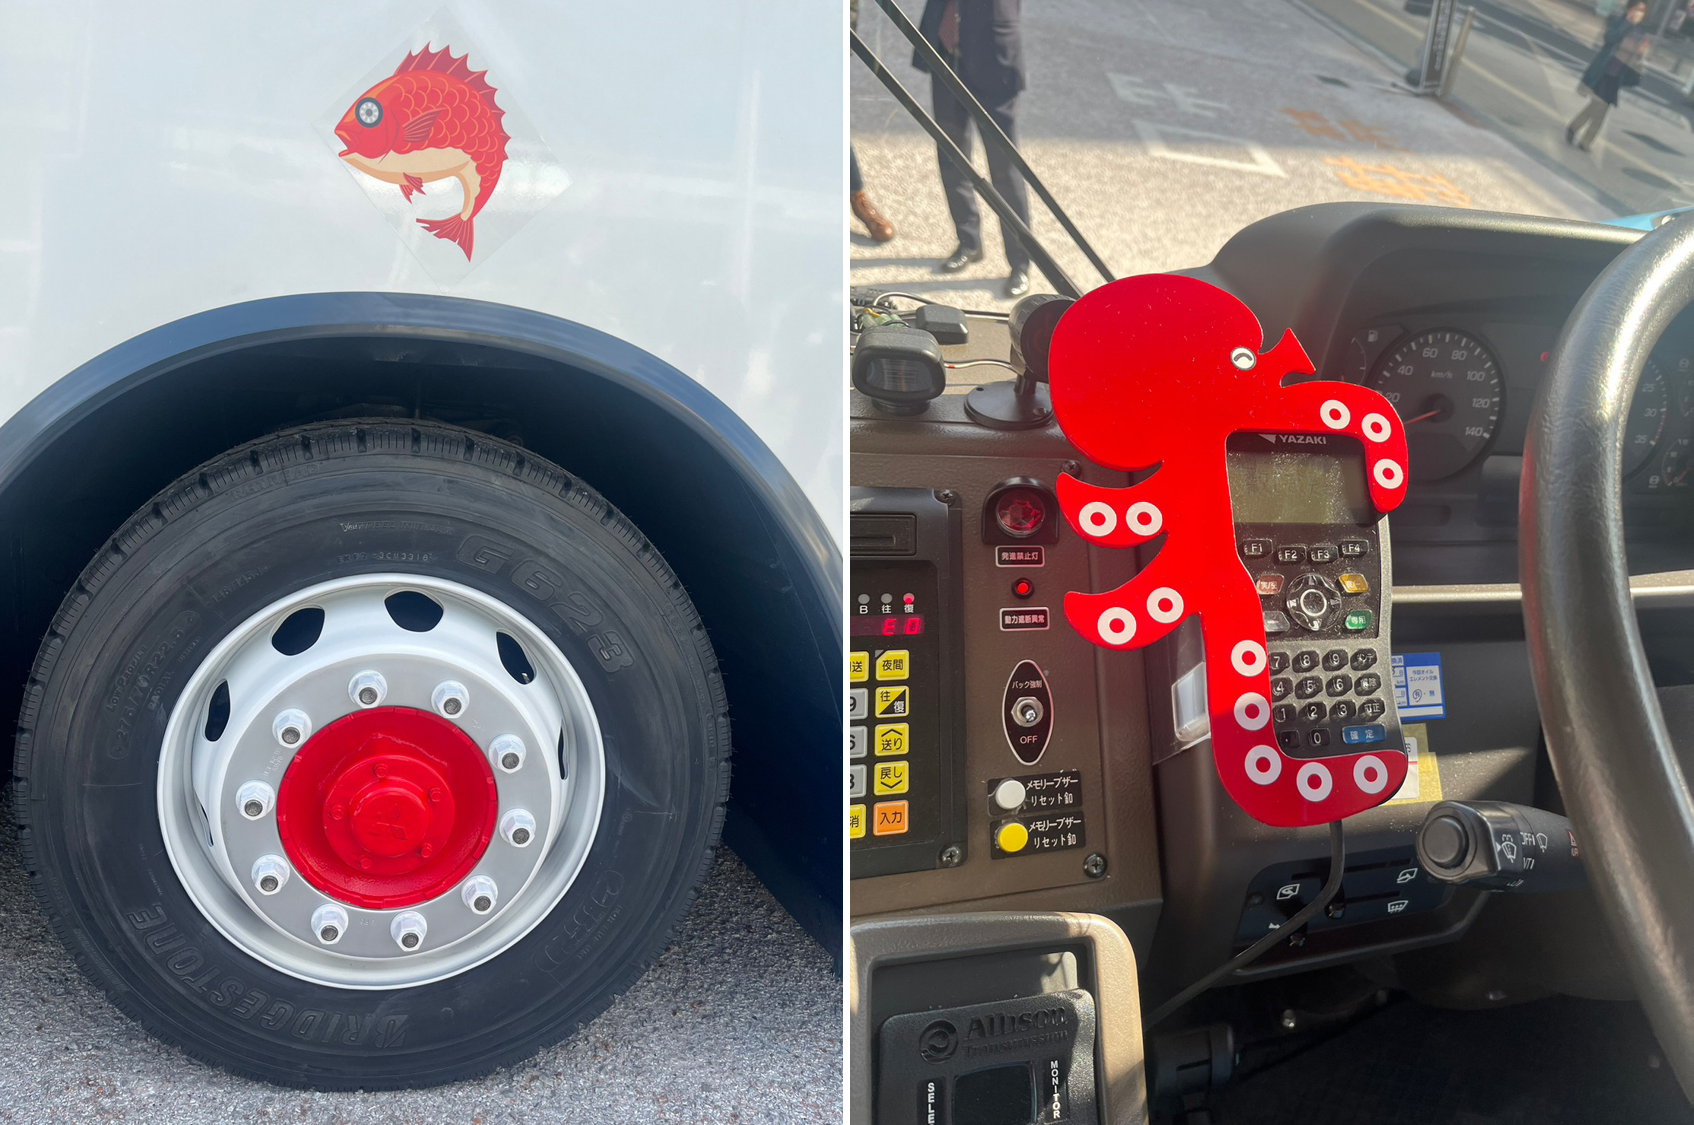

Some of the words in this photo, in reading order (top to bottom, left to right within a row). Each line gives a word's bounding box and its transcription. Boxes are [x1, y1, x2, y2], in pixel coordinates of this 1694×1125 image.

[1422, 347, 1438, 358] 60
[1451, 350, 1467, 361] 80
[1397, 365, 1413, 376] 40
[1431, 370, 1453, 380] km/h
[1466, 370, 1485, 382] 100
[1472, 397, 1490, 409] 120
[1465, 425, 1484, 437] 140
[1279, 434, 1327, 445] YAZAKI
[1251, 543, 1263, 553] F1
[1348, 542, 1361, 552] F4
[1284, 549, 1298, 559] F2
[1317, 550, 1330, 559] F3
[859, 605, 869, 614] B
[881, 604, 892, 614] 往
[903, 604, 914, 614] 復
[882, 659, 904, 671] 夜間
[1273, 656, 1282, 668] 7
[1302, 654, 1311, 667] 8
[1332, 653, 1341, 665] 9
[1012, 680, 1043, 689] バック強制
[1277, 681, 1285, 694] 4
[1306, 680, 1313, 691] 5
[1336, 678, 1344, 690] 6
[880, 690, 891, 703] 往
[893, 701, 905, 714] 復
[1310, 706, 1318, 719] 2
[1340, 704, 1348, 716] 3
[1019, 735, 1038, 744] OFF
[1313, 732, 1322, 744] 0
[881, 738, 903, 751] 送り
[880, 767, 903, 779] 戻し
[1026, 776, 1079, 790] メモリーブザー
[880, 811, 903, 825] 入力
[1050, 1060, 1061, 1120] MONITOR
